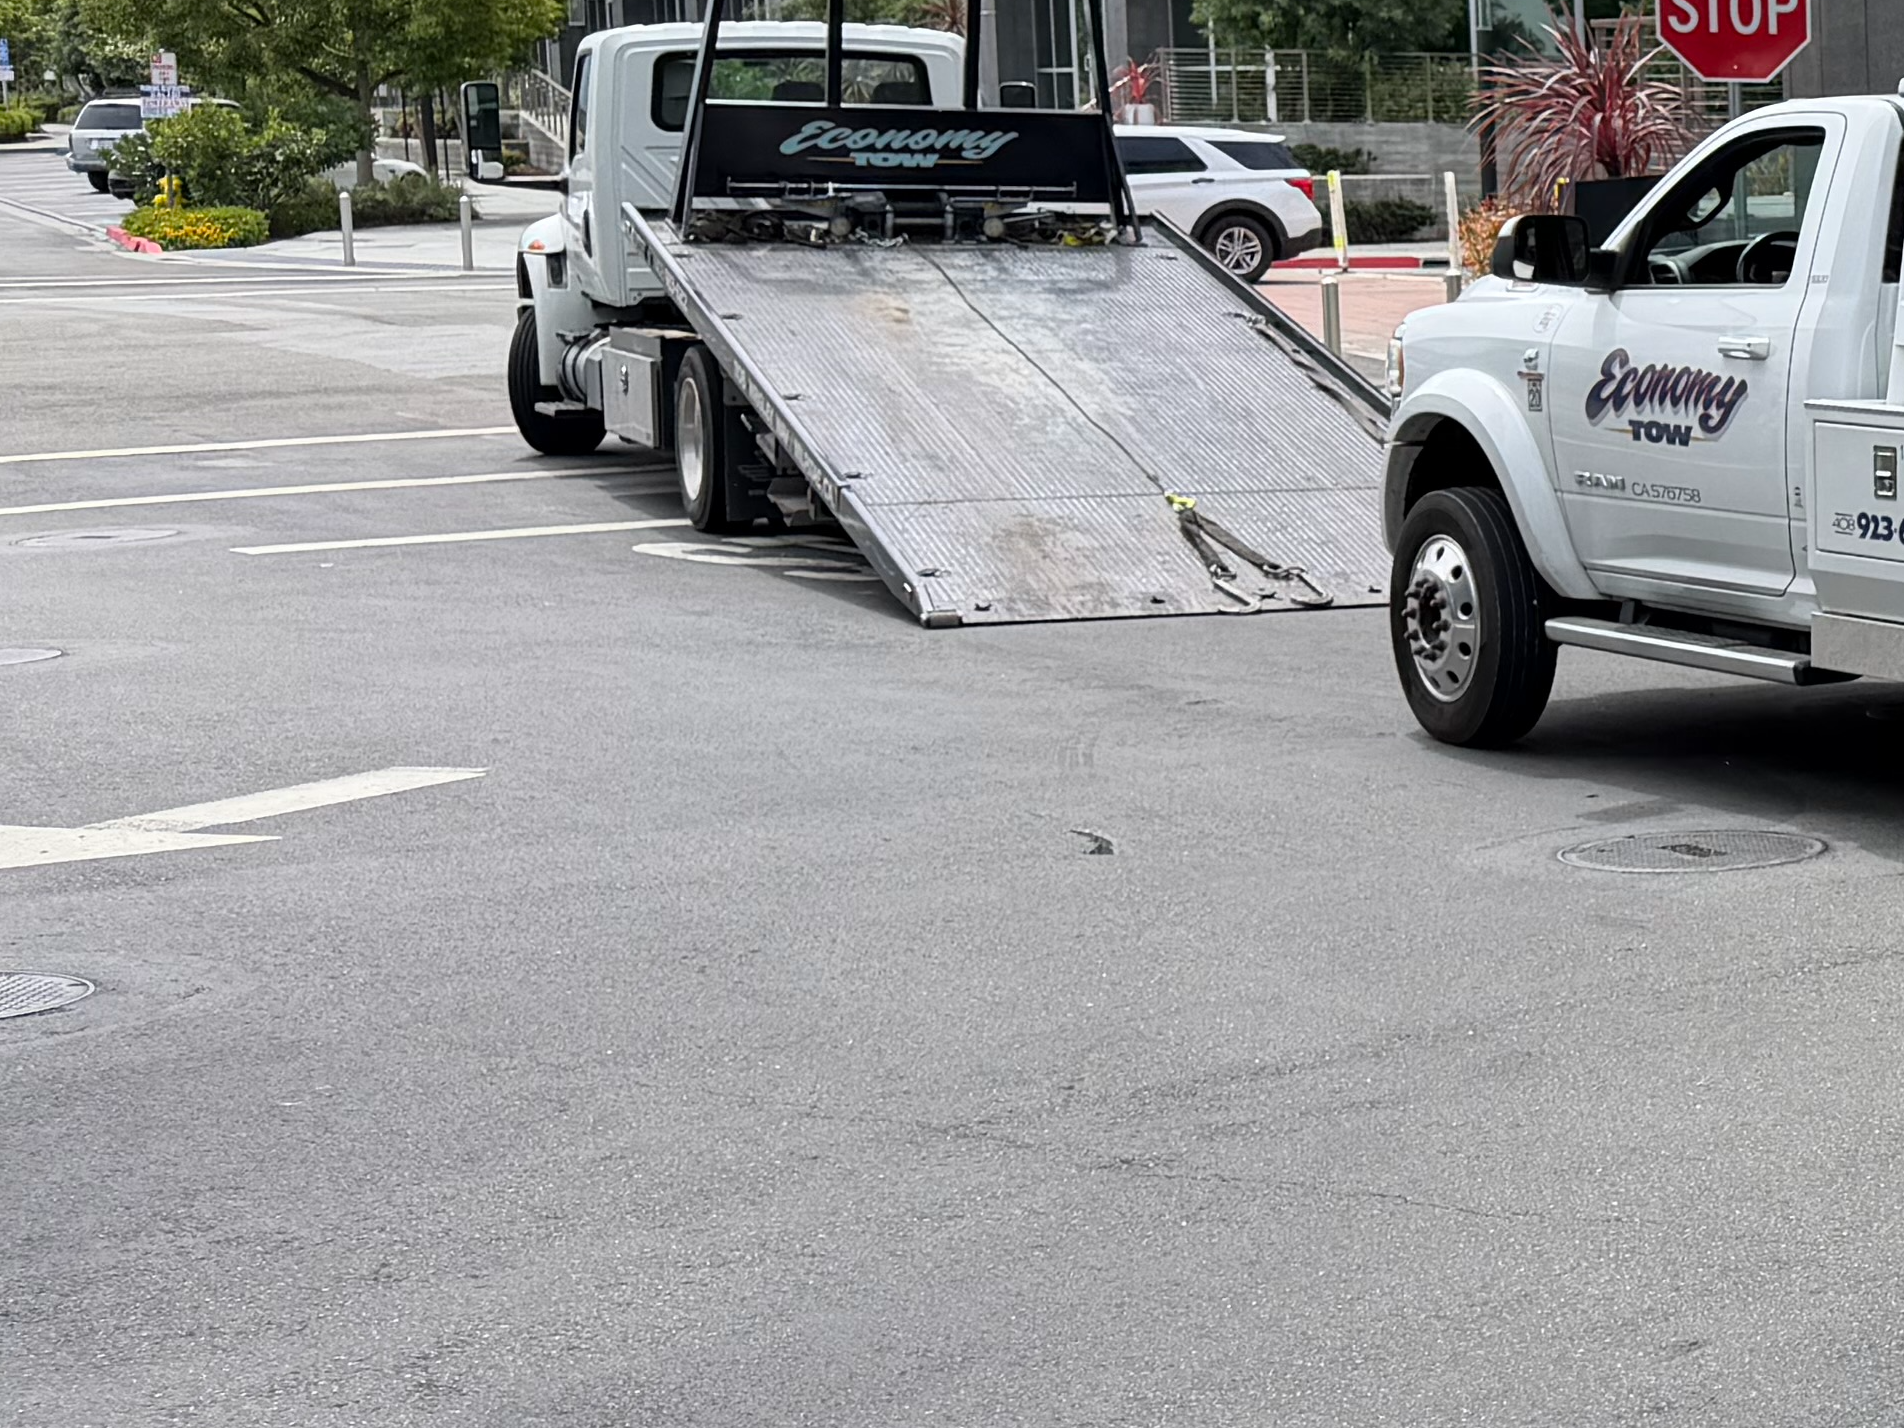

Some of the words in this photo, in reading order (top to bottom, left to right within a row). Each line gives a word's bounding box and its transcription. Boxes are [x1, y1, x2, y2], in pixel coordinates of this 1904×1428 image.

[779, 120, 1019, 160] Economy
[850, 152, 940, 168] TOW
[1585, 347, 1750, 436] Economy
[1628, 419, 1694, 447] TOW
